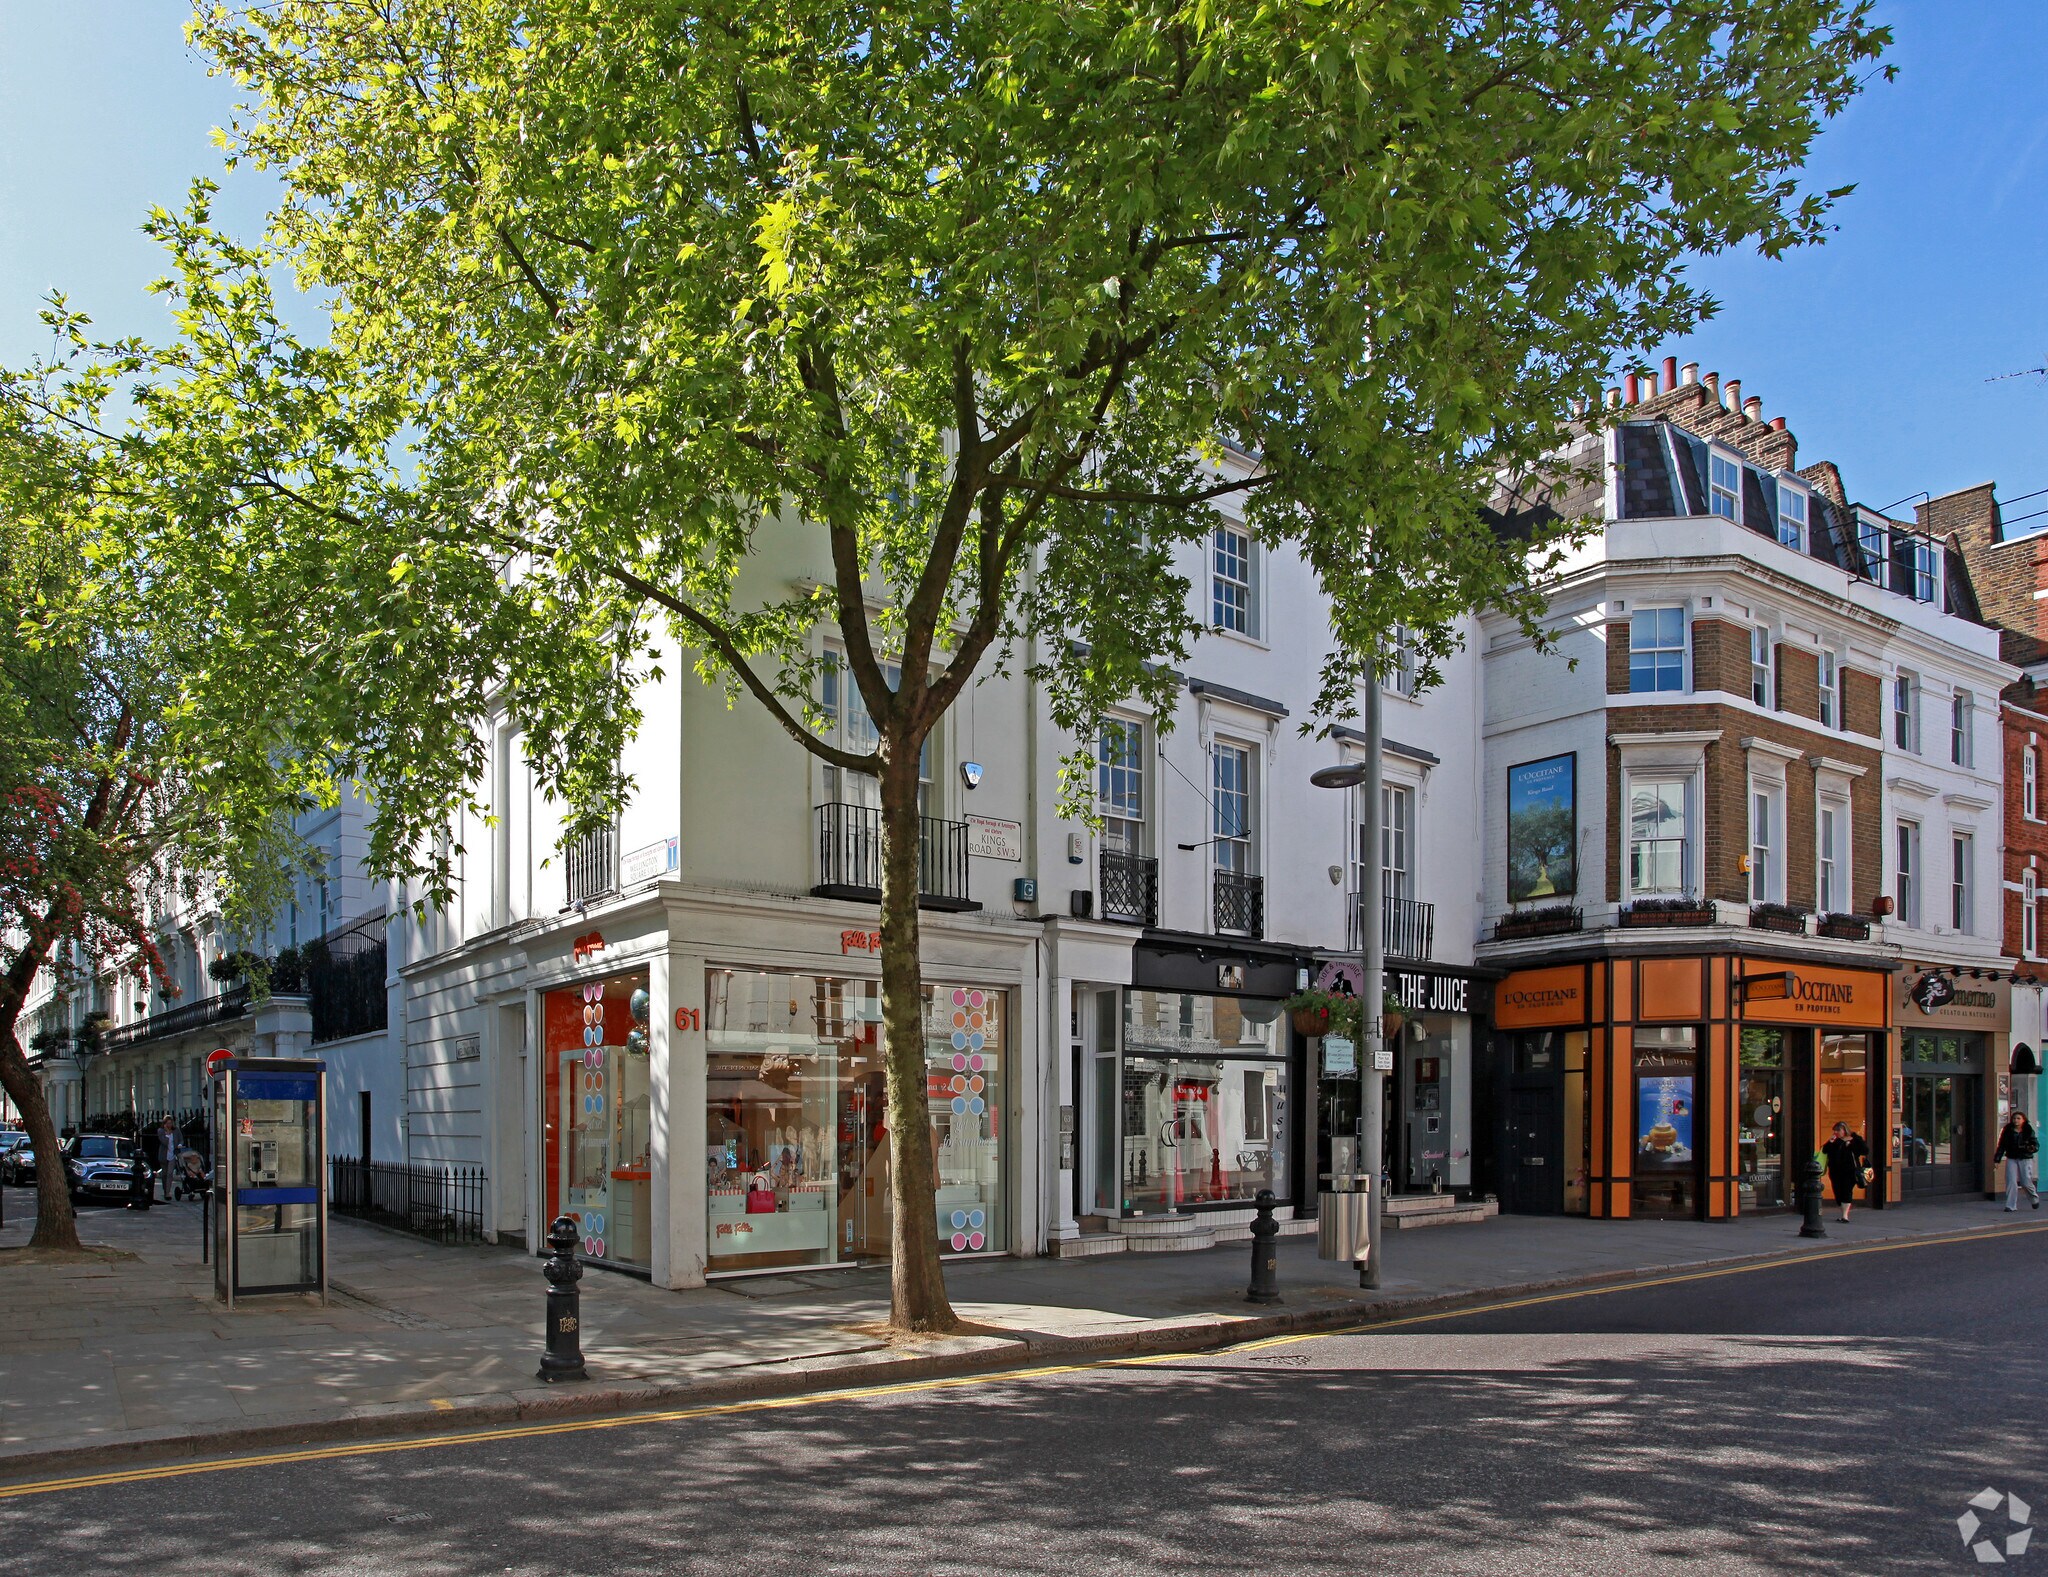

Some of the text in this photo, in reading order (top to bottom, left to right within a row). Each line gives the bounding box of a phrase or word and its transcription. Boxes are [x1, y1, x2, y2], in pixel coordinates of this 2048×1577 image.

[1518, 766, 1563, 781] L'OCCITANE
[981, 834, 1006, 847] KINGS
[1320, 969, 1330, 983] JOE
[1347, 962, 1362, 978] JUICE
[1399, 973, 1426, 1009] THE
[1430, 976, 1468, 1012] JUICE
[1505, 988, 1577, 1005] L'OCCITANE
[1795, 1003, 1841, 1014] EN PROVENCE
[675, 1007, 700, 1031] 61
